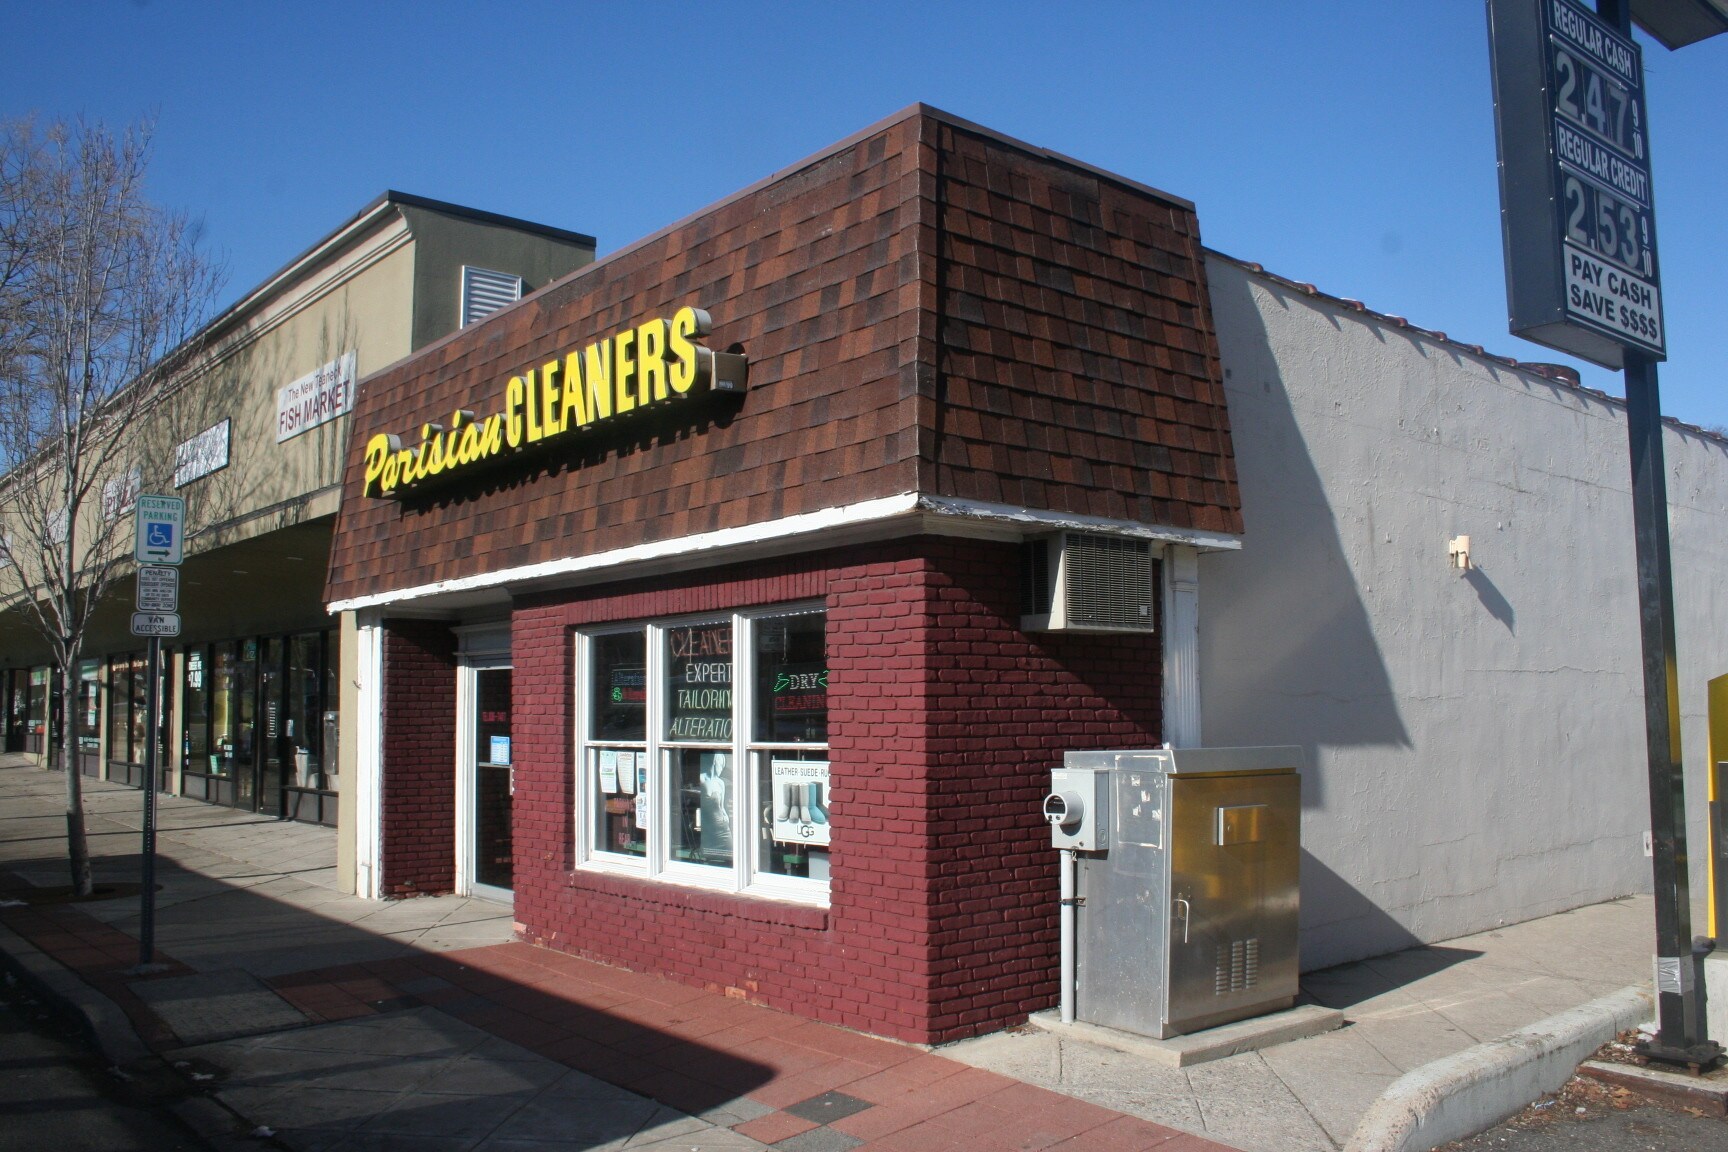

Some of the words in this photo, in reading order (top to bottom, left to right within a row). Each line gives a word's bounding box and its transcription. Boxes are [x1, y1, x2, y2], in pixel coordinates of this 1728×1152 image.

[1554, 1, 1604, 59] REGULAR
[1604, 37, 1632, 79] CASH
[1632, 99, 1639, 127] 9
[1558, 130, 1609, 181] REGULAR
[1610, 158, 1647, 201] CREDIT
[1565, 176, 1640, 269] 2.53
[1641, 216, 1648, 243] 9
[1571, 253, 1603, 285] PAY
[1607, 275, 1653, 311] CASH
[1570, 283, 1616, 323] SAVE
[1620, 304, 1658, 341] $$$$
[288, 388, 299, 402] The
[300, 382, 314, 396] New
[363, 409, 505, 498] Parisian
[505, 305, 702, 449] CLEANERS
[279, 403, 301, 434] FISH
[303, 379, 351, 424] MARKET
[141, 500, 181, 511] RESERVED
[143, 511, 178, 522] PARKING
[136, 624, 177, 633] ACCESSIBLE
[148, 615, 165, 623] VAN
[686, 663, 733, 683] EXPERT
[789, 672, 820, 690] DRY
[678, 689, 733, 709] TAILORIN
[669, 717, 733, 738] ALTERATIO
[774, 767, 799, 776] LEATHER
[800, 768, 818, 777] SUEDE
[820, 768, 829, 777] RU
[796, 825, 815, 838] UGG
